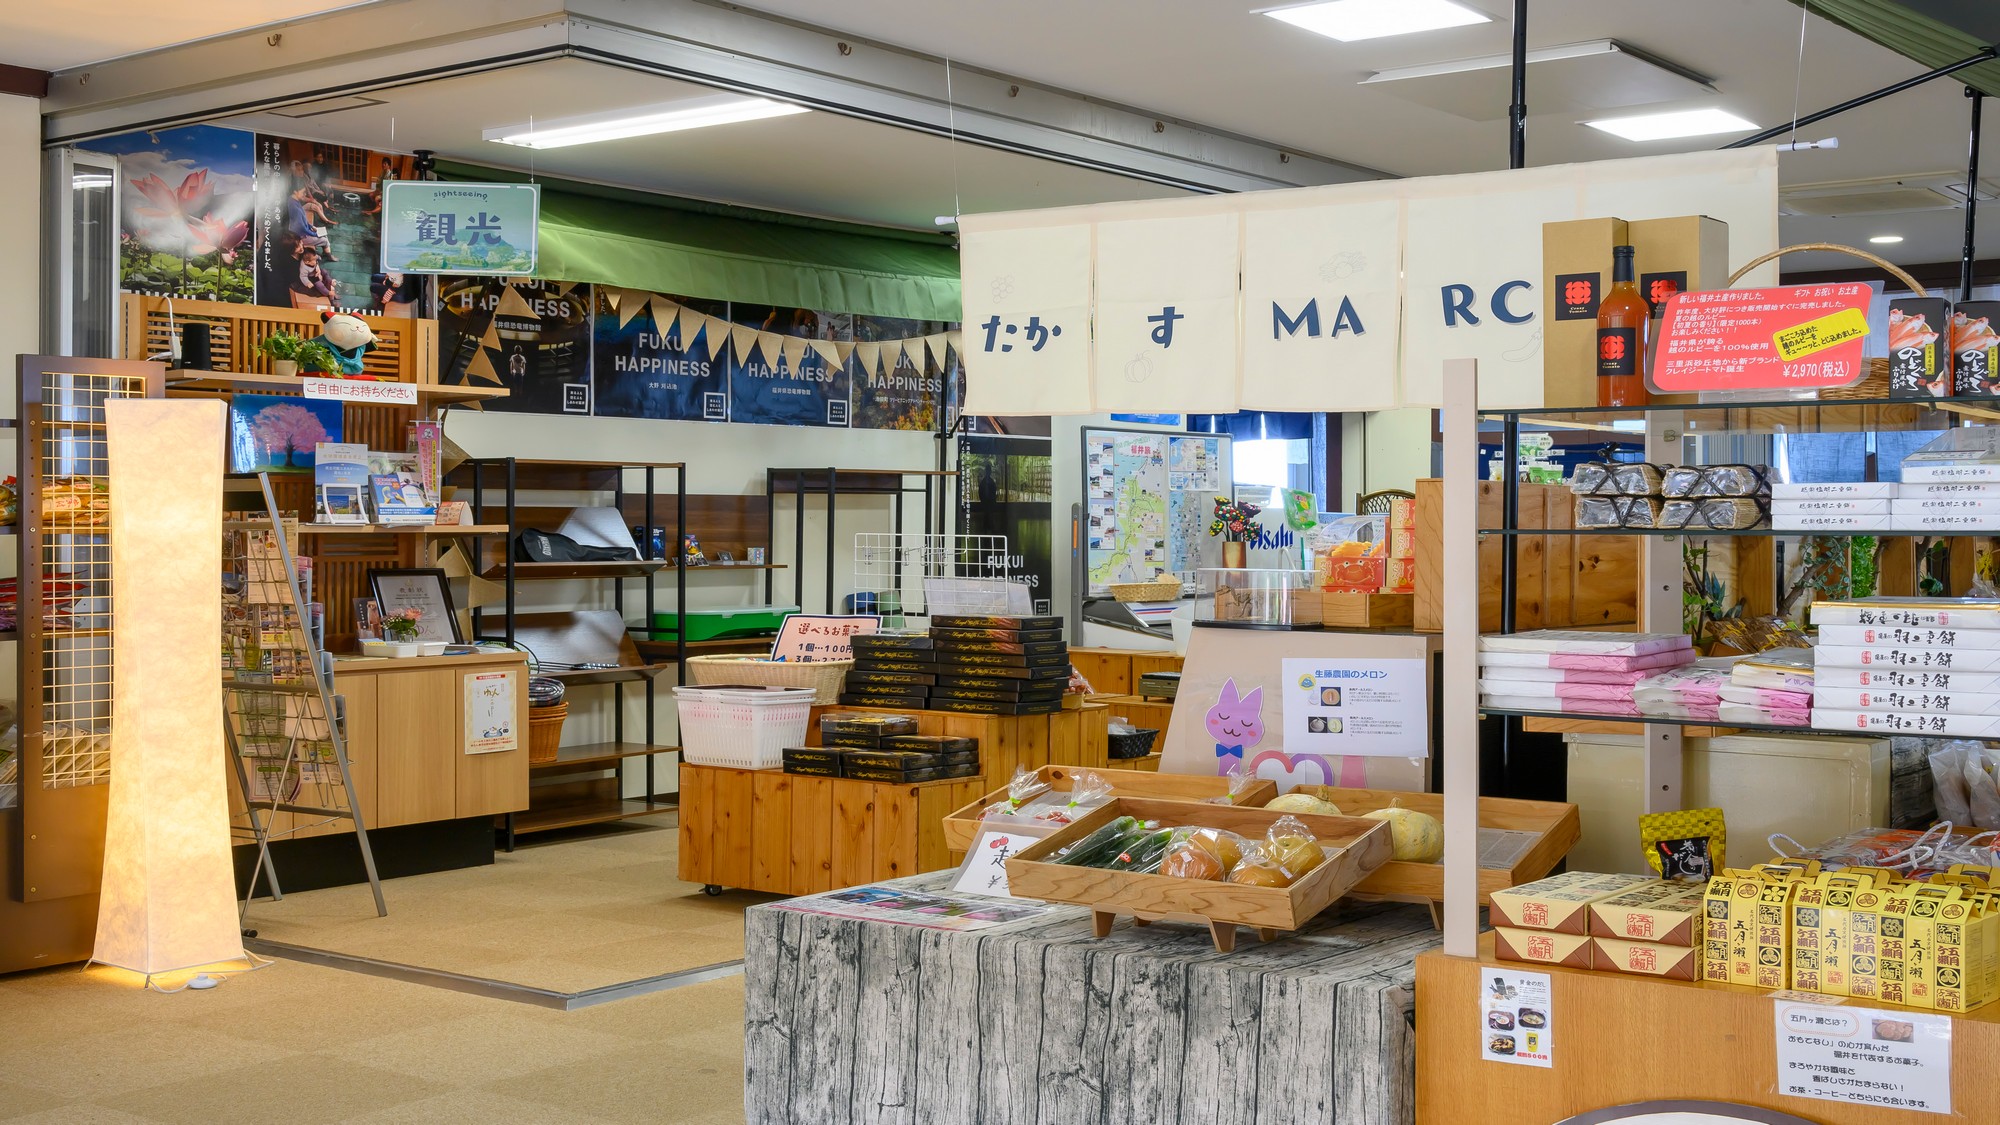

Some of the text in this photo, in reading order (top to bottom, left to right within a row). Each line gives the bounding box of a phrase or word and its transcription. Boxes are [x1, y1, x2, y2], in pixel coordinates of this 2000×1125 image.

[433, 190, 488, 200] sightseeing
[415, 212, 502, 247] 観光
[1679, 292, 1765, 305] 新しい福井土産作りました。
[1794, 286, 1859, 298] ギフト お祝い お土産
[1676, 301, 1846, 316] 昨年度、大好評につき販売開始すぐに完売しました。
[639, 333, 683, 351] FUKU
[1669, 338, 1724, 347] 福井県が誇る
[1779, 326, 1818, 343] まごころ込めた
[615, 356, 710, 377] HAPPINESS
[1665, 357, 1780, 369] 三里浜砂丘地から新ブランド
[1665, 365, 1745, 375] クレイジートマト誕生
[1897, 347, 1926, 391] のどぐろ
[1960, 349, 1989, 393] のどぐろ
[868, 376, 943, 393] HAPPINESS
[1892, 366, 1900, 390] ふりかけ
[307, 382, 415, 401] ご自由にお持ちください
[987, 555, 1024, 569] FUKUI
[798, 623, 860, 637] 選べるお菓子
[1315, 670, 1388, 679] 生藤農園のメロン
[1833, 1050, 1924, 1067] 福井を代表するお菓子。
[1789, 1062, 1856, 1075] まろやかな風味と
[1812, 1075, 1904, 1092] 香ばしさがたまらない！
[1789, 1086, 1930, 1109] お茶・コーヒーどちらにも合います。
